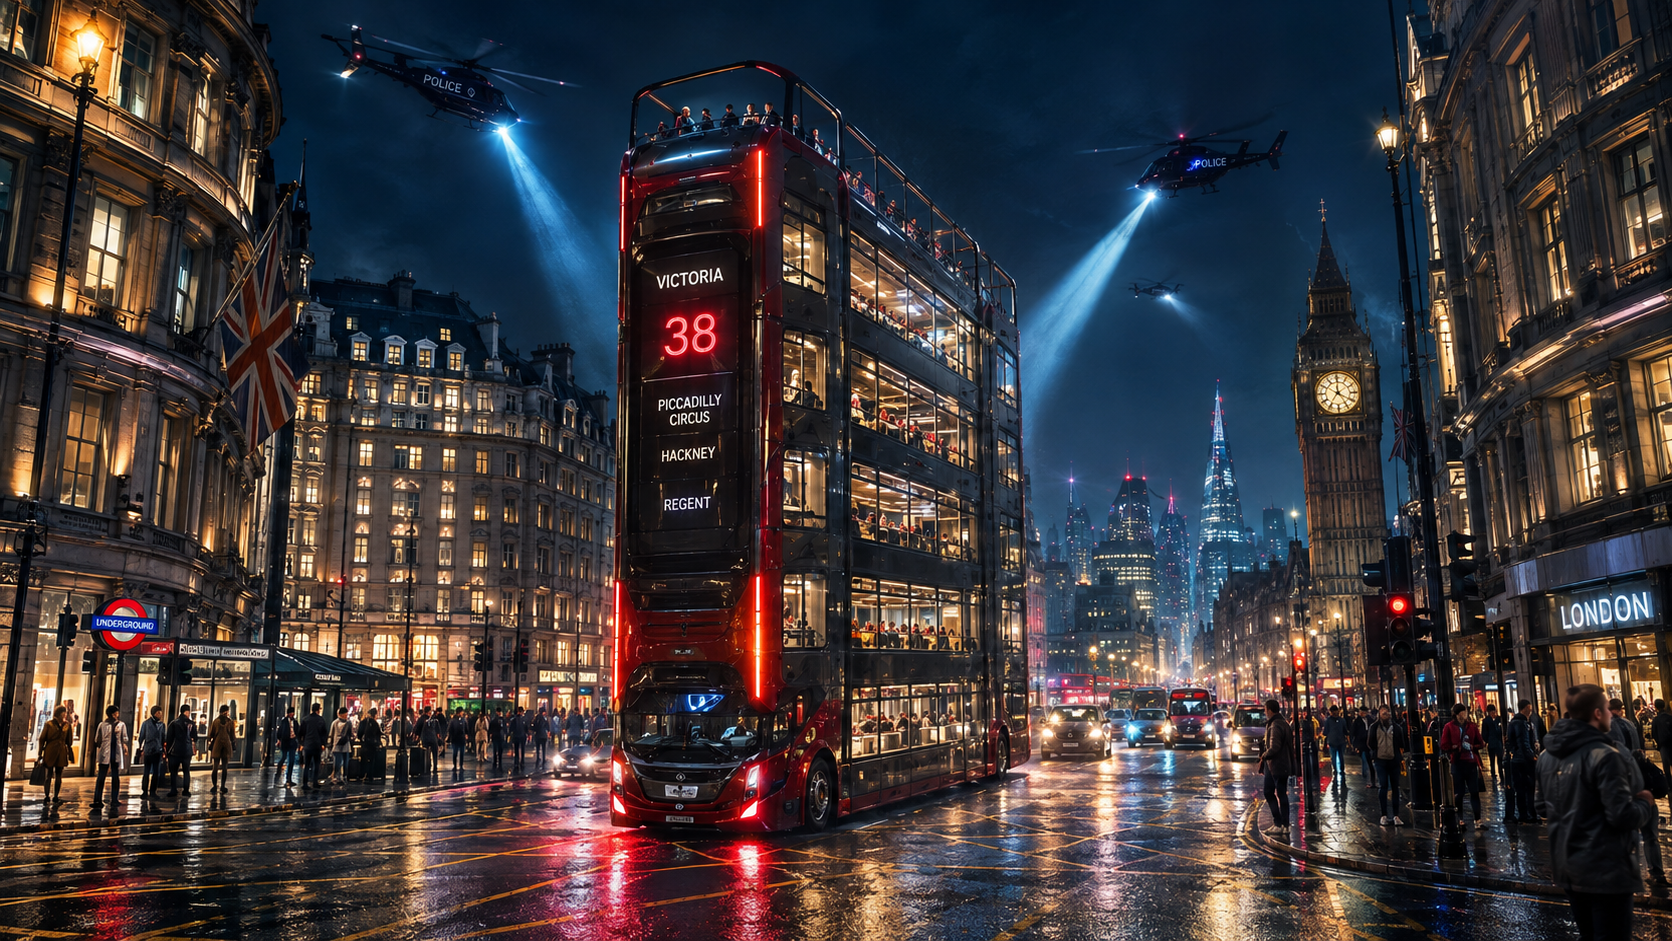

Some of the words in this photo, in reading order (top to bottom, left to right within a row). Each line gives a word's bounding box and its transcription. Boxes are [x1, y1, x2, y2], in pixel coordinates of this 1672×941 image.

[423, 74, 462, 93] POLICE
[1195, 157, 1227, 169] POLICE
[656, 267, 724, 289] VICTORIA
[664, 313, 716, 356] 38
[658, 394, 722, 411] PICCADILLY
[669, 411, 710, 426] CIRCUS
[661, 446, 716, 462] HACKNEY
[664, 496, 711, 511] REGENT
[1561, 592, 1649, 630] LONDON
[96, 618, 154, 631] UNDERGROUND
